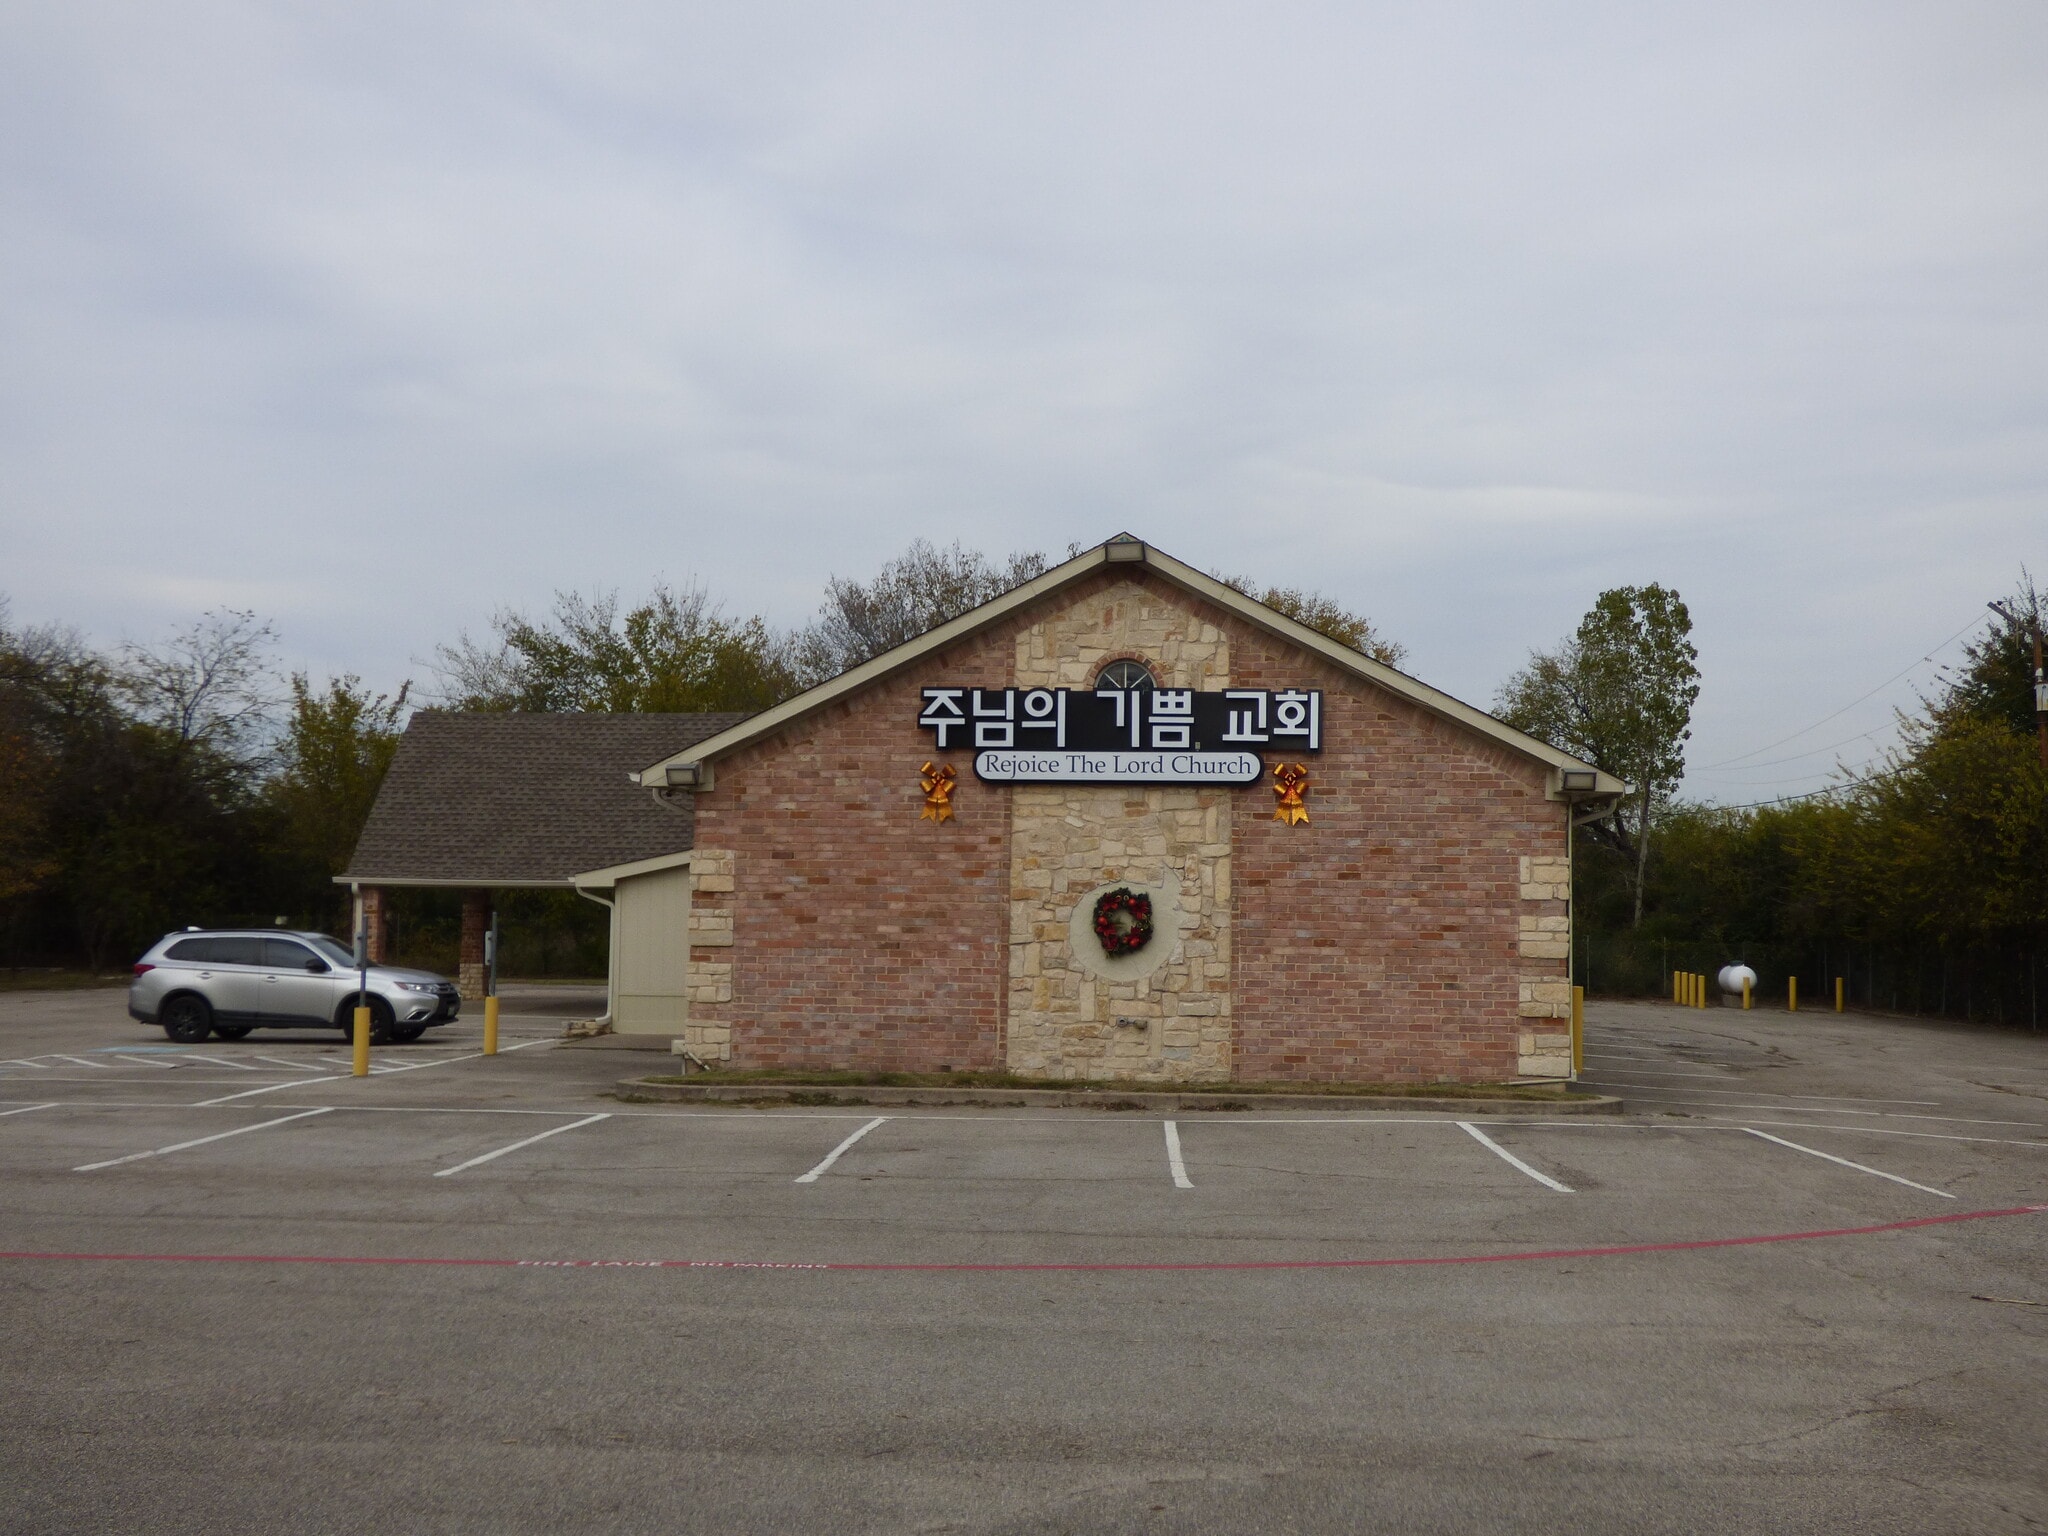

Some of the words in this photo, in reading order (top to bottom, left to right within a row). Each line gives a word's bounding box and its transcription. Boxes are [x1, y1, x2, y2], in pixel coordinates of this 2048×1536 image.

[919, 689, 1067, 748] 주님의
[1096, 690, 1195, 748] 기쁨
[1222, 690, 1320, 749] 교회
[984, 754, 1060, 779] Rejoice
[1066, 754, 1107, 774] The
[1113, 755, 1165, 774] Lord
[1171, 755, 1252, 775] Church
